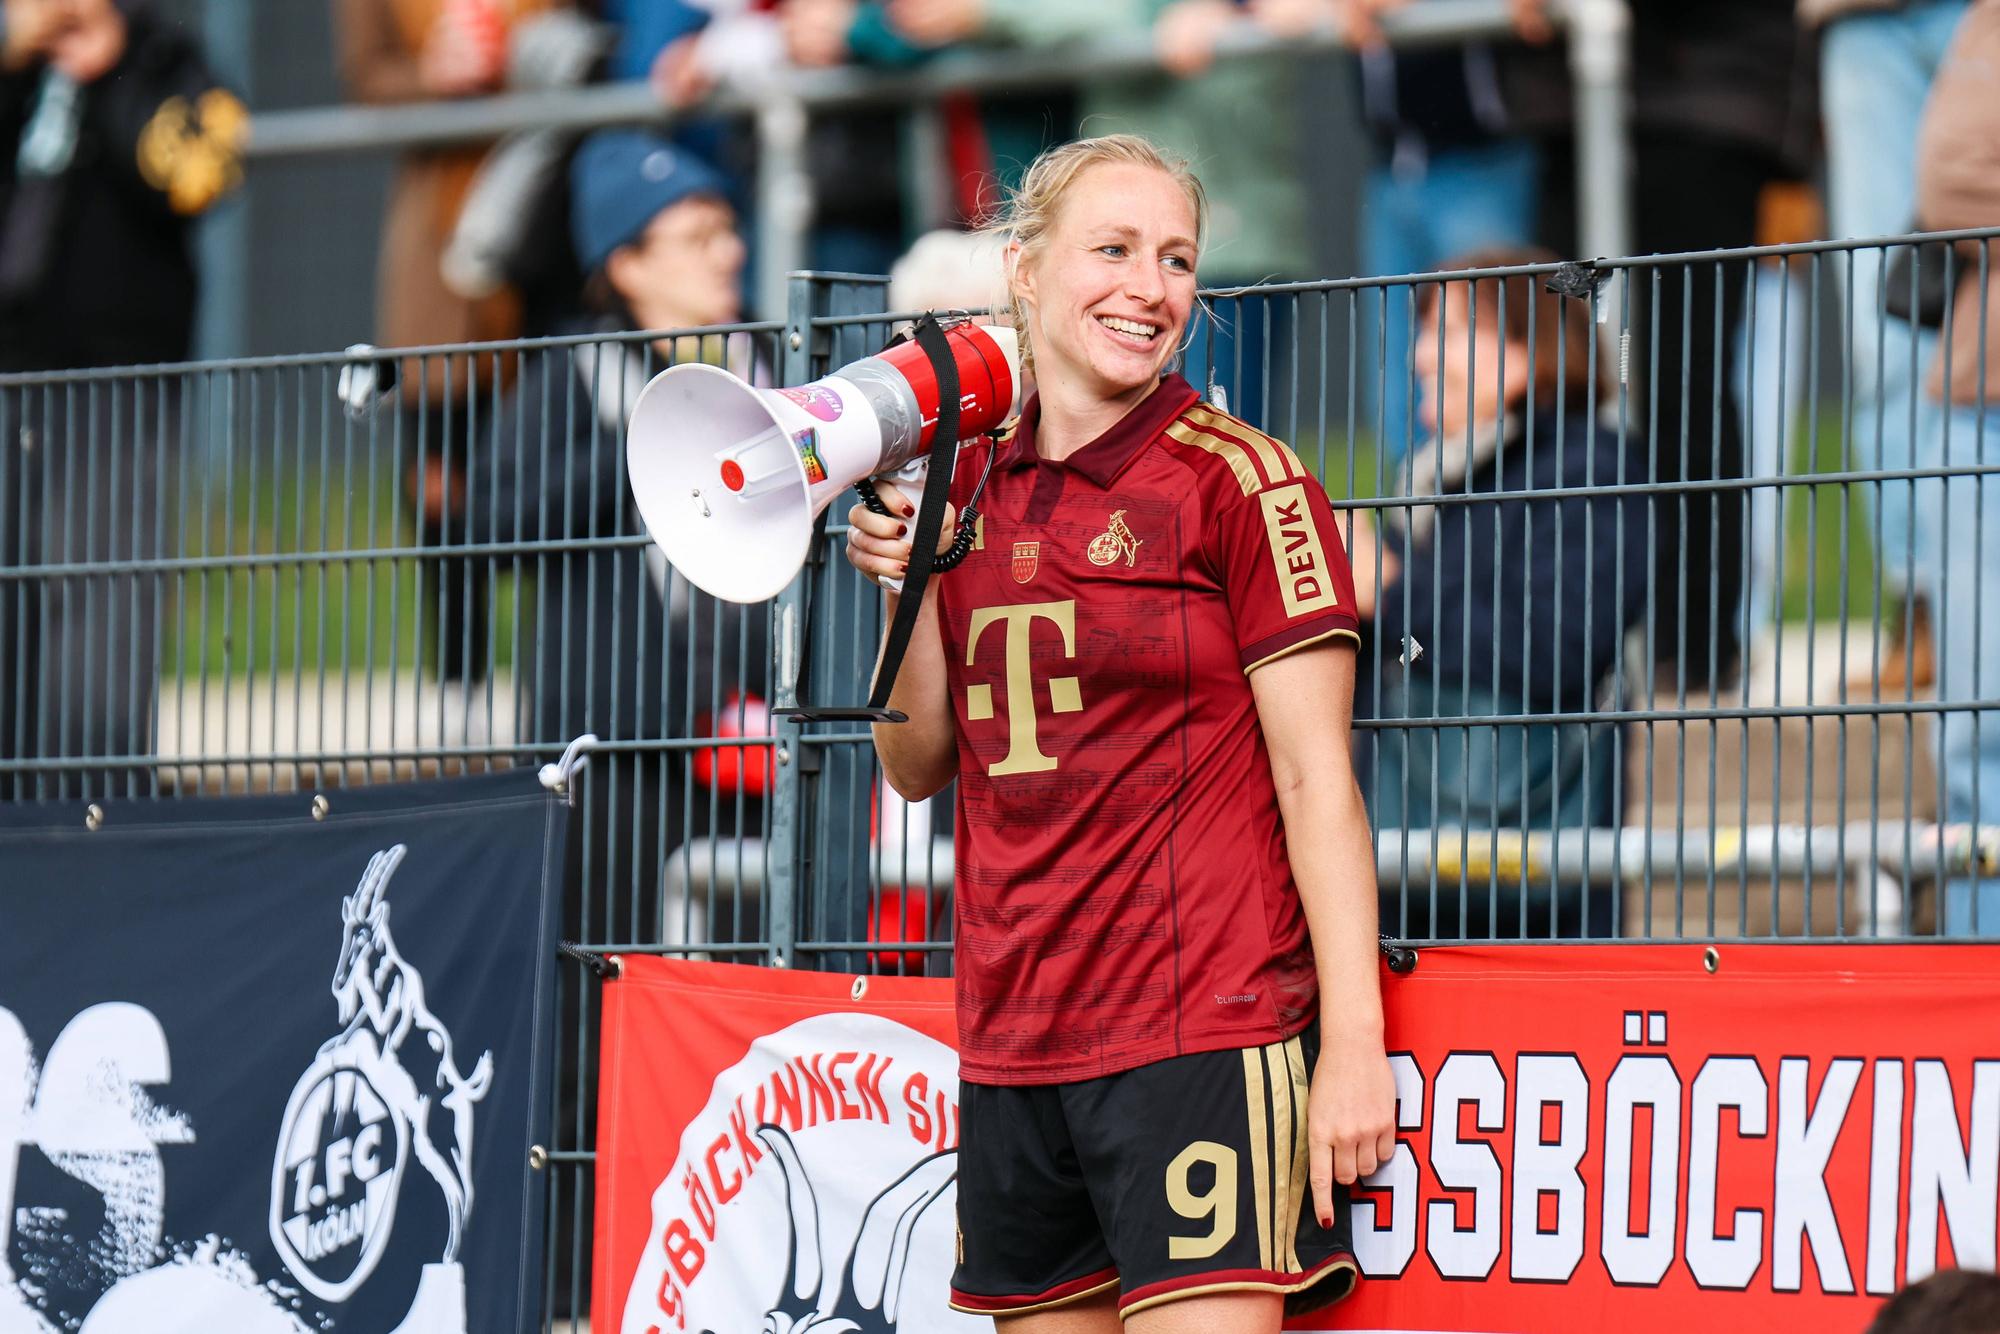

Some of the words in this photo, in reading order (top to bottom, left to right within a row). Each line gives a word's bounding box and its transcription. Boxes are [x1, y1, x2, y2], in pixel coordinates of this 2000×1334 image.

[1274, 498, 1322, 603] DEVK
[966, 599, 1083, 777] T
[293, 1122, 382, 1213] 1.FC
[641, 1051, 894, 1334] SBÖCKINNEN
[902, 1071, 959, 1153] SI
[1165, 1140, 1238, 1260] 9
[306, 1198, 366, 1263] KÖLN
